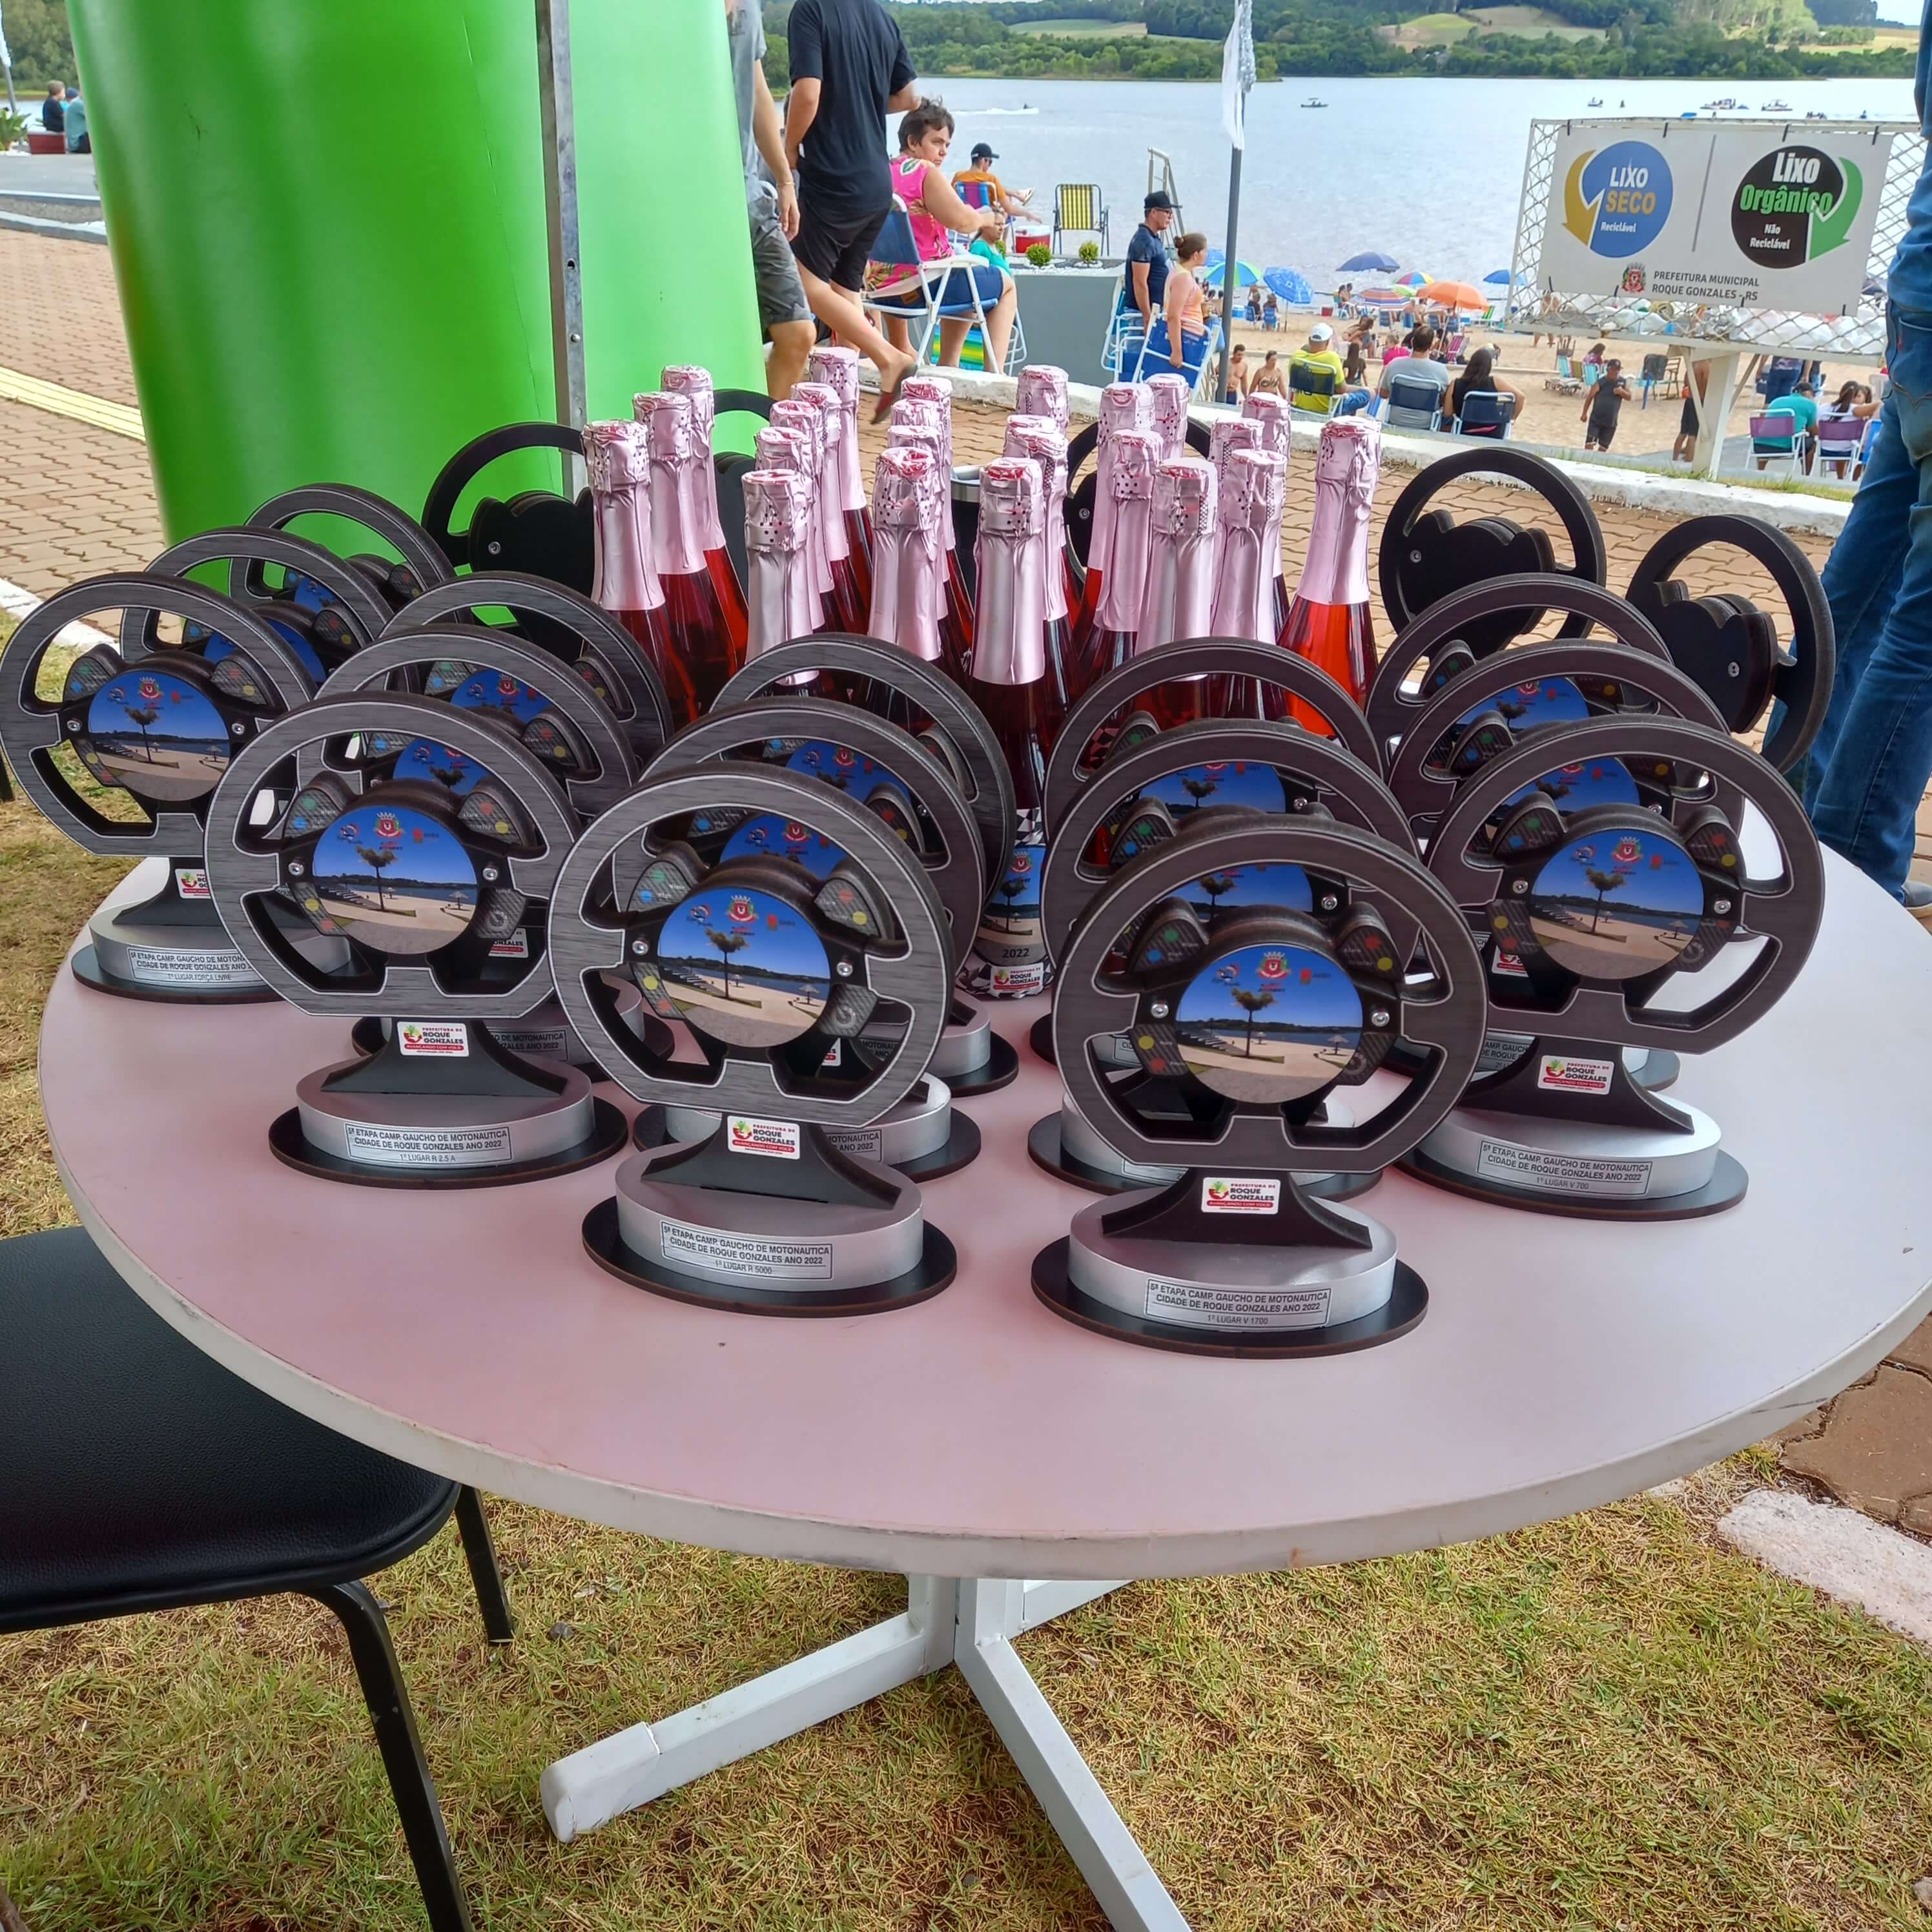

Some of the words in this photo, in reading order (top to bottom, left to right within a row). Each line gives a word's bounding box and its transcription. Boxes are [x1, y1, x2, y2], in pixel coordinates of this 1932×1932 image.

[1772, 152, 1820, 183] Lixo
[1610, 167, 1649, 189] LIXO
[1606, 190, 1656, 214] SECO
[1740, 185, 1833, 214] Orgânico
[1601, 221, 1636, 233] Reciclável
[1764, 224, 1781, 234] Não
[1749, 238, 1791, 250] Reciclável
[1654, 271, 1707, 283] PREFEITURA
[1709, 275, 1760, 287] MUNICIPAL
[1652, 284, 1683, 295] ROQUE
[1686, 287, 1736, 299] GONZALES
[1745, 291, 1758, 300] RS
[138, 952, 156, 961] ETAPA
[1002, 948, 1029, 958] 2022
[137, 960, 158, 969] CIDADE
[513, 1033, 564, 1042] MOTONAUTICA
[1491, 1051, 1517, 1059] ROQUE
[356, 1129, 378, 1139] ETAPA
[379, 1132, 400, 1140] CAMP.
[450, 1131, 508, 1142] MOTONAUTICA
[753, 1129, 781, 1137] ROQUE
[355, 1138, 381, 1147] CIDADE
[394, 1142, 421, 1150] ROQUE
[423, 1142, 464, 1151] GONZALES
[485, 1140, 502, 1149] 2022
[753, 1136, 795, 1146] GONZALES
[1492, 1146, 1516, 1158] ETAPA
[1518, 1152, 1541, 1163] CAMP.
[1543, 1157, 1578, 1168] GAUCHO
[1592, 1163, 1649, 1172] MOTONAUTICA
[1488, 1155, 1516, 1167] CIDADE
[1530, 1164, 1559, 1175] ROQUE
[1561, 1168, 1603, 1180] GONZALES
[1624, 1173, 1641, 1181] 2022
[1545, 1178, 1568, 1188] LUGAR
[1570, 1180, 1575, 1189] V
[672, 1228, 694, 1240] ETAPA
[695, 1234, 717, 1244] CAMP.
[720, 1239, 754, 1251] GAUCHO
[769, 1246, 829, 1255] MOTONAUTICA
[670, 1237, 696, 1250] CIDADE
[710, 1247, 737, 1259] ROQUE
[739, 1251, 782, 1263] GONZALES
[784, 1255, 802, 1264] ANO
[723, 1261, 746, 1271] LUGAR
[755, 1266, 772, 1275] 5000
[1160, 1285, 1186, 1297] ETAPA
[1189, 1290, 1213, 1300] CAMP.
[1216, 1293, 1253, 1302] GAUCHO
[1269, 1293, 1328, 1303] MOTONAUTICA
[1156, 1294, 1187, 1306] CIDADE
[1203, 1302, 1233, 1311] ROQUE
[1235, 1304, 1280, 1313] GONZALES
